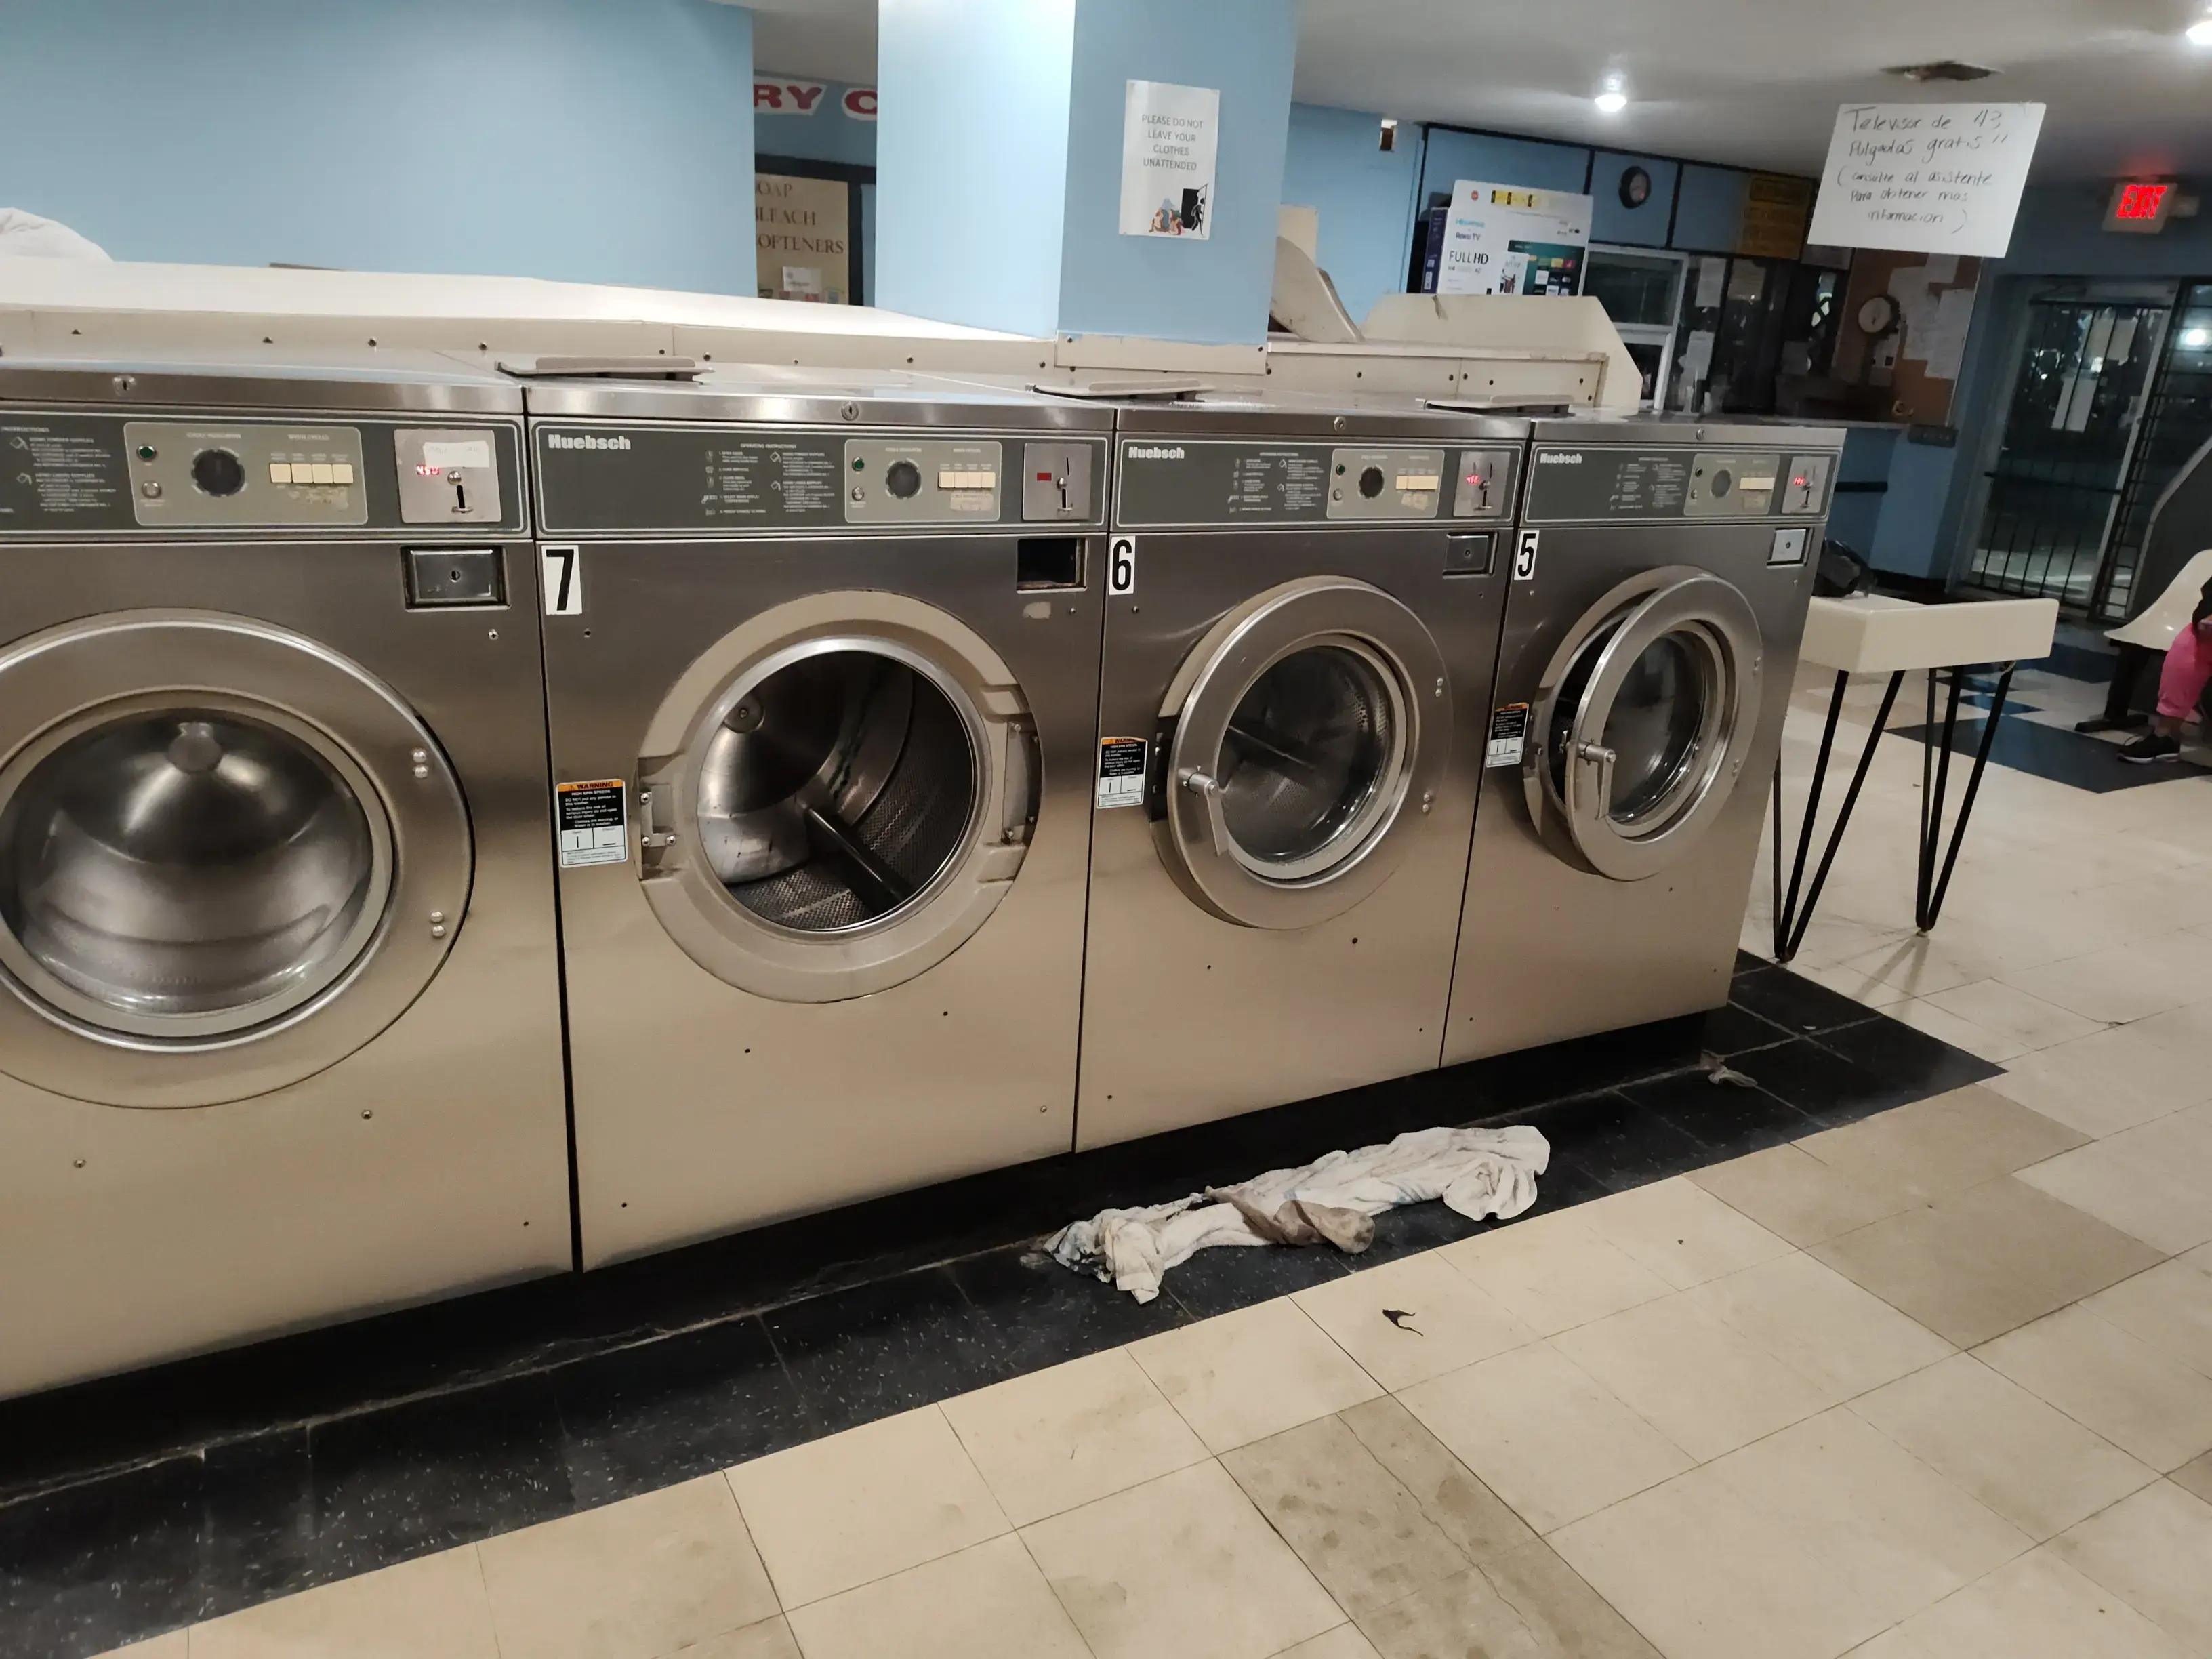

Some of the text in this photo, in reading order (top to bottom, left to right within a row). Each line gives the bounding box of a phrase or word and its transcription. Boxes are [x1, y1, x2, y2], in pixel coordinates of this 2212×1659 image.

[1142, 114, 1203, 129] PLEASE DO NOT
[1931, 114, 1951, 129] de
[1973, 109, 2002, 130] 43
[1148, 129, 1196, 142] LEAVE YOUR
[1153, 144, 1189, 156] CLOTHES
[1922, 136, 1982, 164] gratis
[1143, 157, 1197, 171] UNATTENDED
[1905, 171, 1919, 184] al
[1928, 171, 1993, 186] asistente
[756, 180, 793, 197] OAP
[1880, 186, 1929, 201] obtener
[2116, 184, 2167, 219] EXIT
[757, 233, 844, 254] OFTENERS
[1449, 250, 1489, 264] FULL HD
[548, 434, 631, 450] Huebsch
[1128, 447, 1185, 459] Huebsch
[1540, 453, 1582, 464] Huebsch
[1518, 533, 1536, 577] 5
[1112, 539, 1132, 590] 6
[546, 549, 574, 611] 7
[577, 781, 613, 790] WARNING
